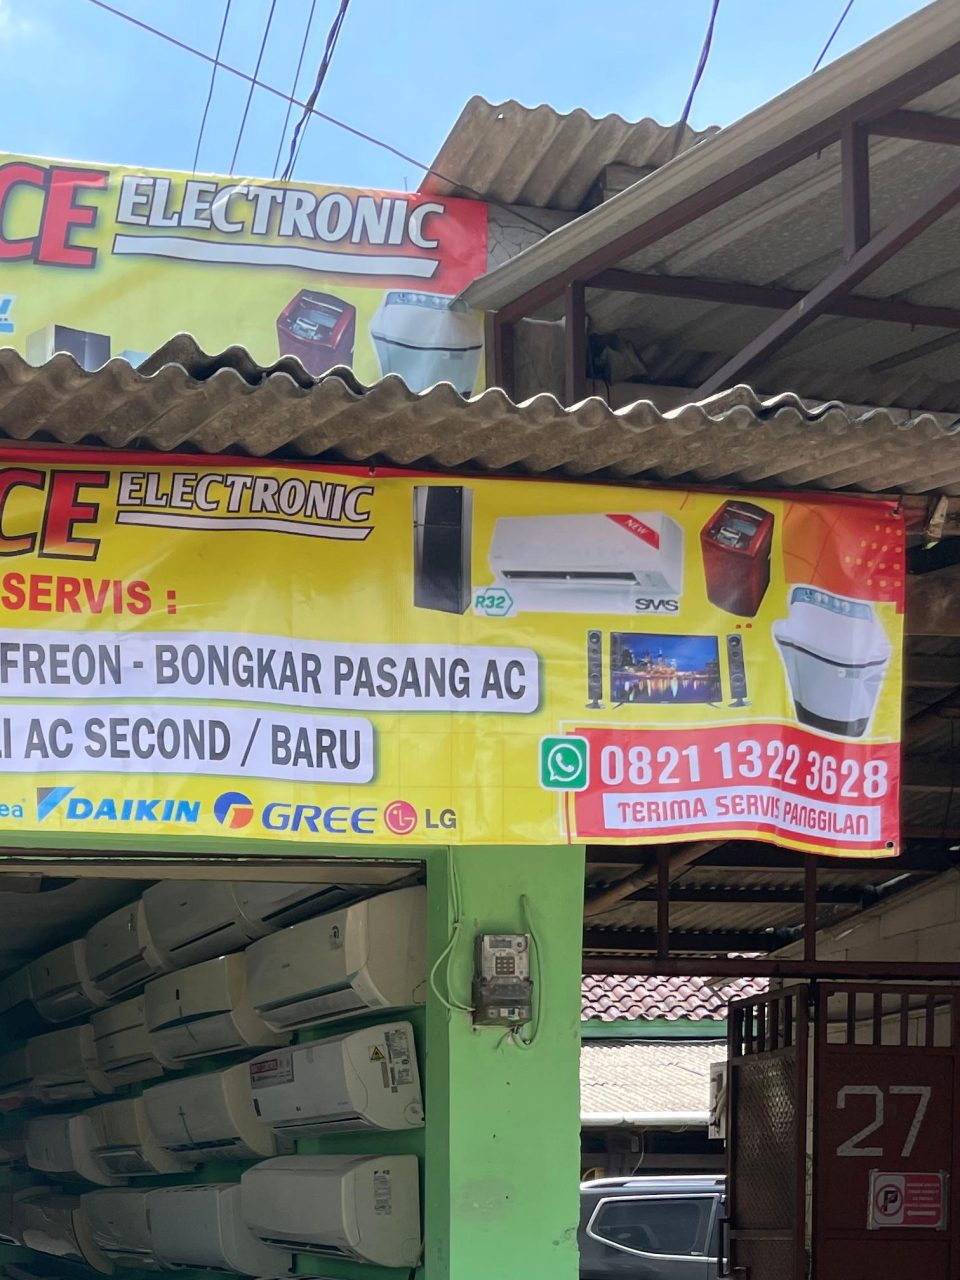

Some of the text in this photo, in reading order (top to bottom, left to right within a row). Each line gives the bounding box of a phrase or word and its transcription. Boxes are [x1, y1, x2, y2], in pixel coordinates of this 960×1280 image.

[115, 175, 445, 250] ELECTRONIC
[116, 472, 375, 523] ELECTRONIC
[626, 519, 648, 535] NEW
[0, 572, 152, 616] SERVIS
[475, 595, 506, 609] R32
[635, 598, 679, 611] SMS
[0, 642, 121, 685] FREON
[157, 644, 321, 695] BONGKAR
[334, 656, 471, 698] PASANG
[481, 659, 527, 700] AC
[25, 719, 72, 760] AC
[84, 719, 230, 761] SECOND
[272, 725, 361, 771] BARU
[600, 739, 889, 798] 0821 1322 3628
[69, 797, 200, 824] DAIKIN
[262, 803, 377, 834] GREE
[425, 809, 457, 829] LG
[617, 798, 707, 823] TERIMA
[716, 795, 780, 819] SERVIS
[836, 1085, 932, 1157] 27
